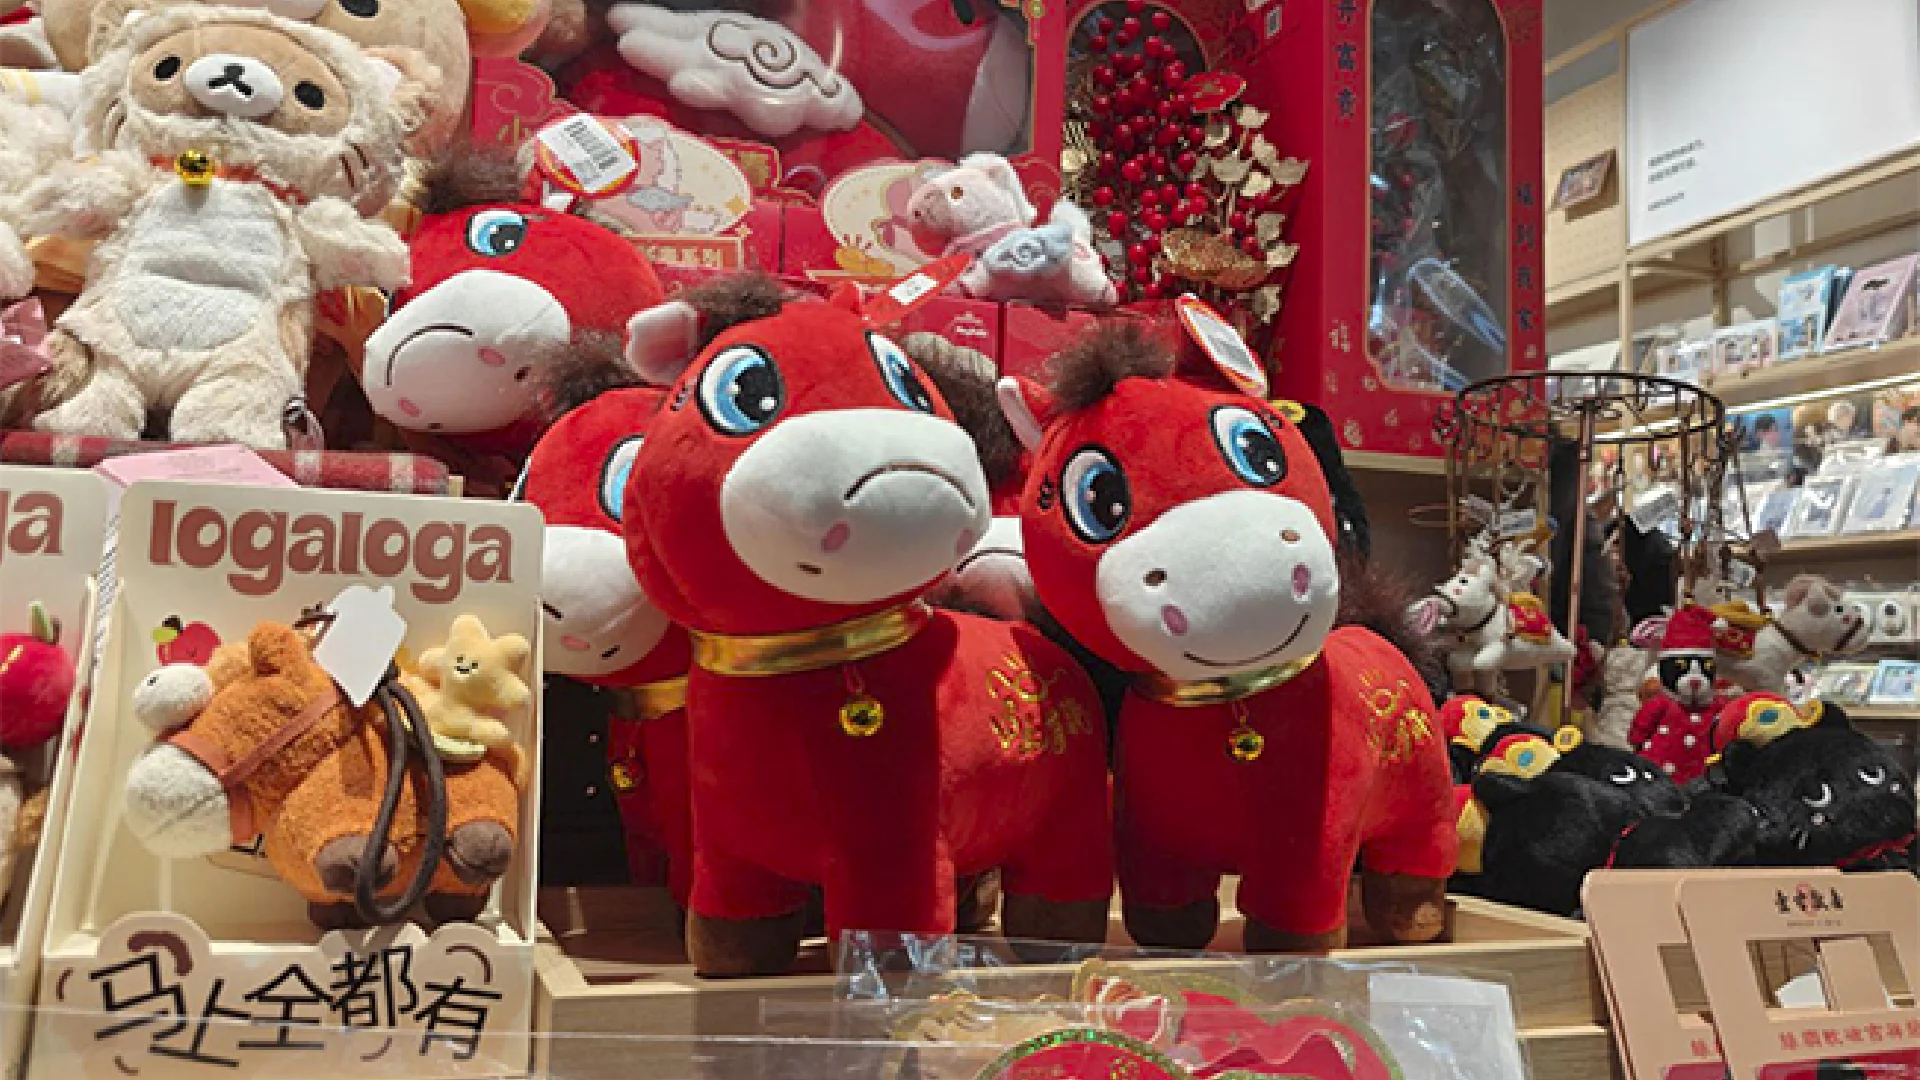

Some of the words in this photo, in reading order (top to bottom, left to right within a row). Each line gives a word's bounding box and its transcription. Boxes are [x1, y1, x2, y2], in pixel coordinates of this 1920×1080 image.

[0, 488, 63, 566] a
[149, 499, 514, 604] logaloga
[88, 945, 502, 1067] 马上全都有
